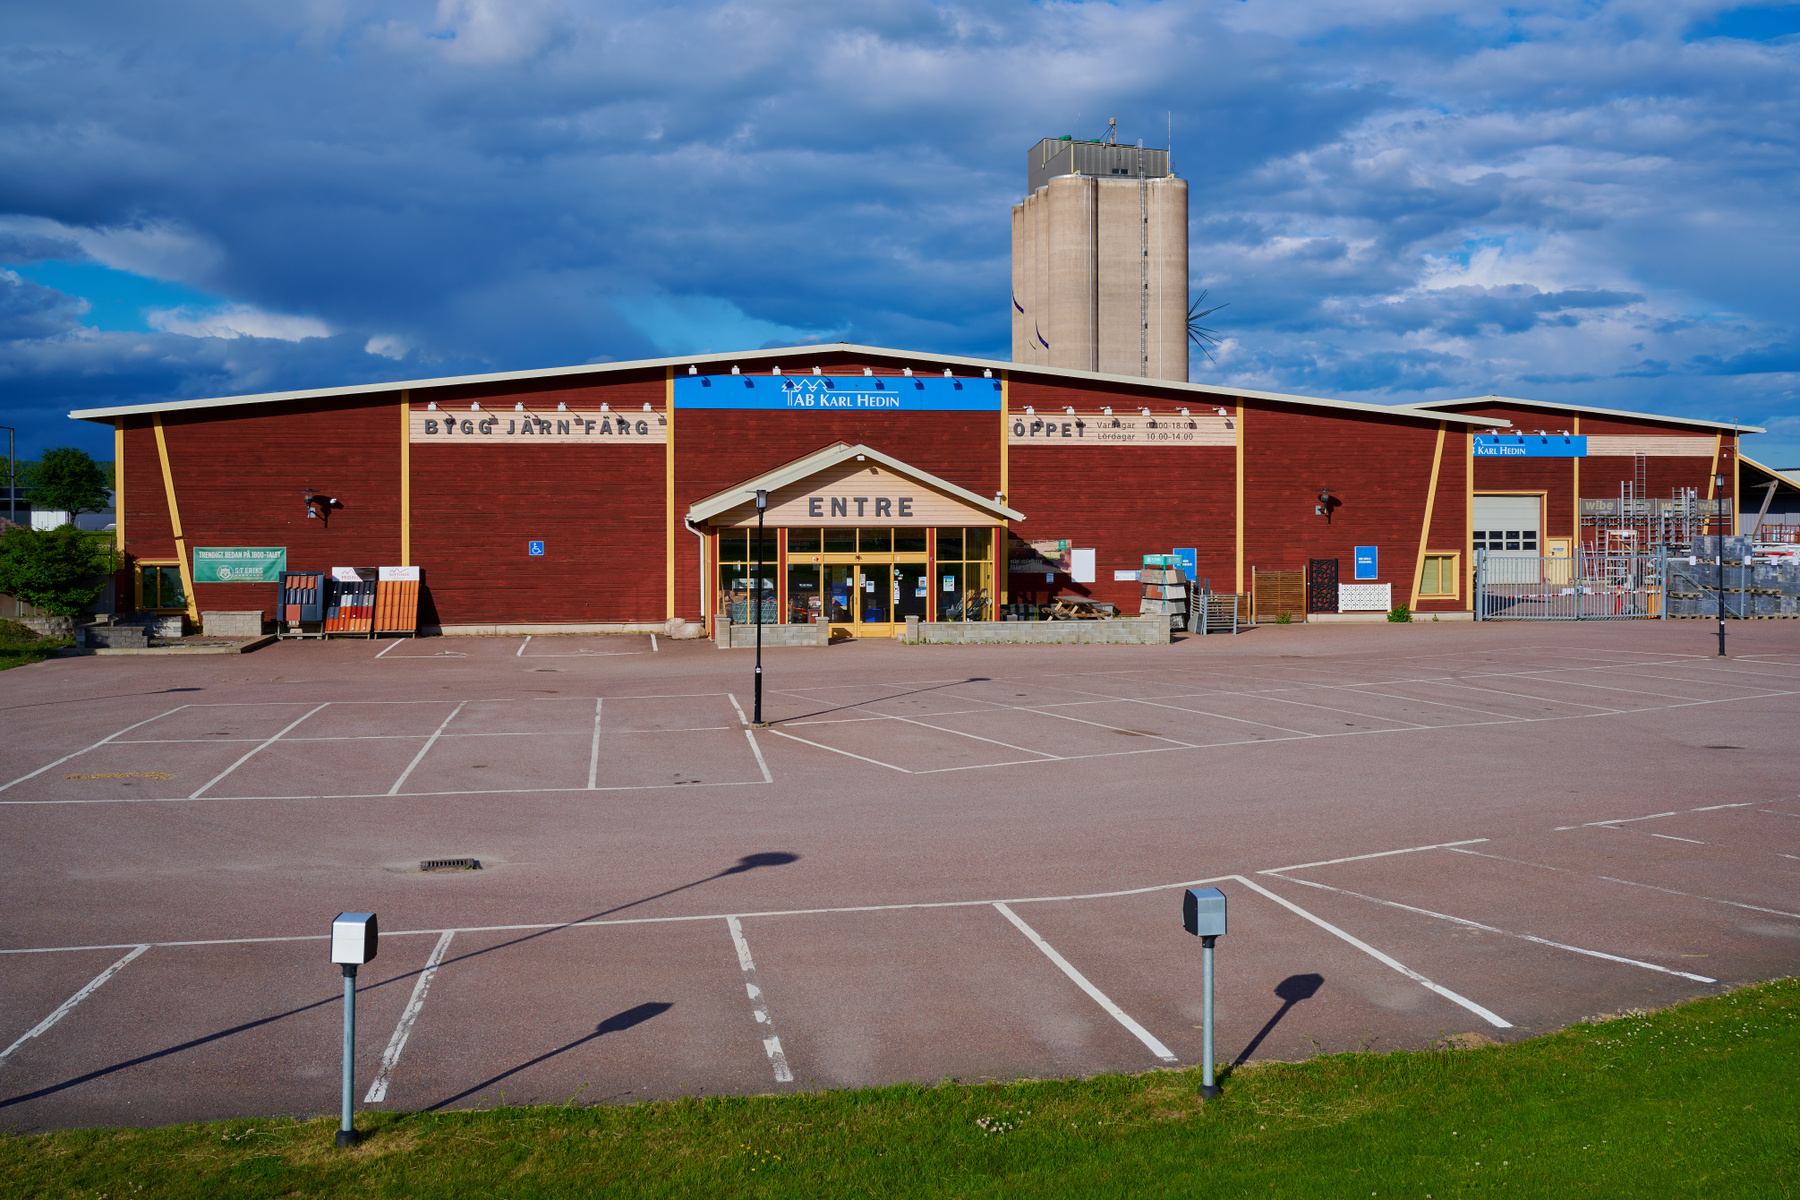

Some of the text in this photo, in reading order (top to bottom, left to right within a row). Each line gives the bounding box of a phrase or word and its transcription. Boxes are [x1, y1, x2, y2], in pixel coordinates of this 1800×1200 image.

[794, 394, 899, 407] AB KARL HEDIN
[424, 415, 649, 435] BYGG JÄRN FÄRG
[1012, 418, 1085, 437] ÖPPET
[1096, 421, 1135, 430] Vardagar
[1097, 432, 1135, 441] Lördagar
[1478, 446, 1498, 455] KARL
[1500, 446, 1526, 455] HEDIN
[808, 497, 914, 517] ENTRE
[1585, 500, 1614, 510] wibe
[199, 551, 224, 559] TRENDIGT
[225, 551, 243, 559] REDAN
[243, 550, 251, 559] PÅ
